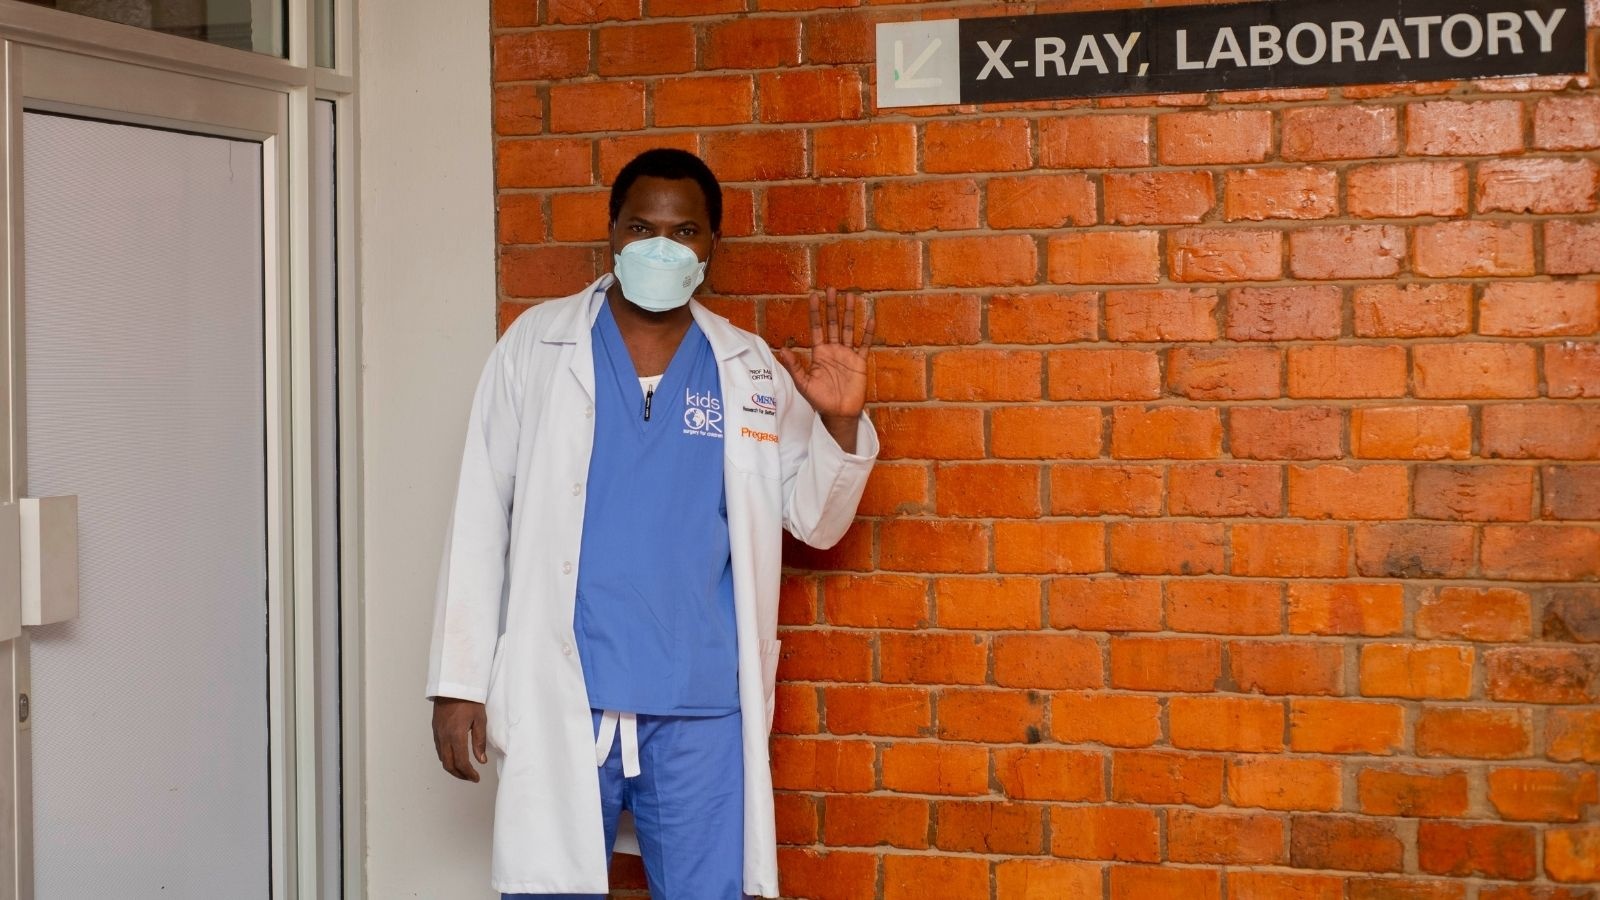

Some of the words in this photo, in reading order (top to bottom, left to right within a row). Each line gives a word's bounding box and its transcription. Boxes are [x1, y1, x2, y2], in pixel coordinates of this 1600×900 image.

[975, 31, 1150, 80] X-RAY,
[1175, 8, 1567, 71] LABORATORY
[686, 387, 720, 410] kids
[684, 407, 723, 433] OR
